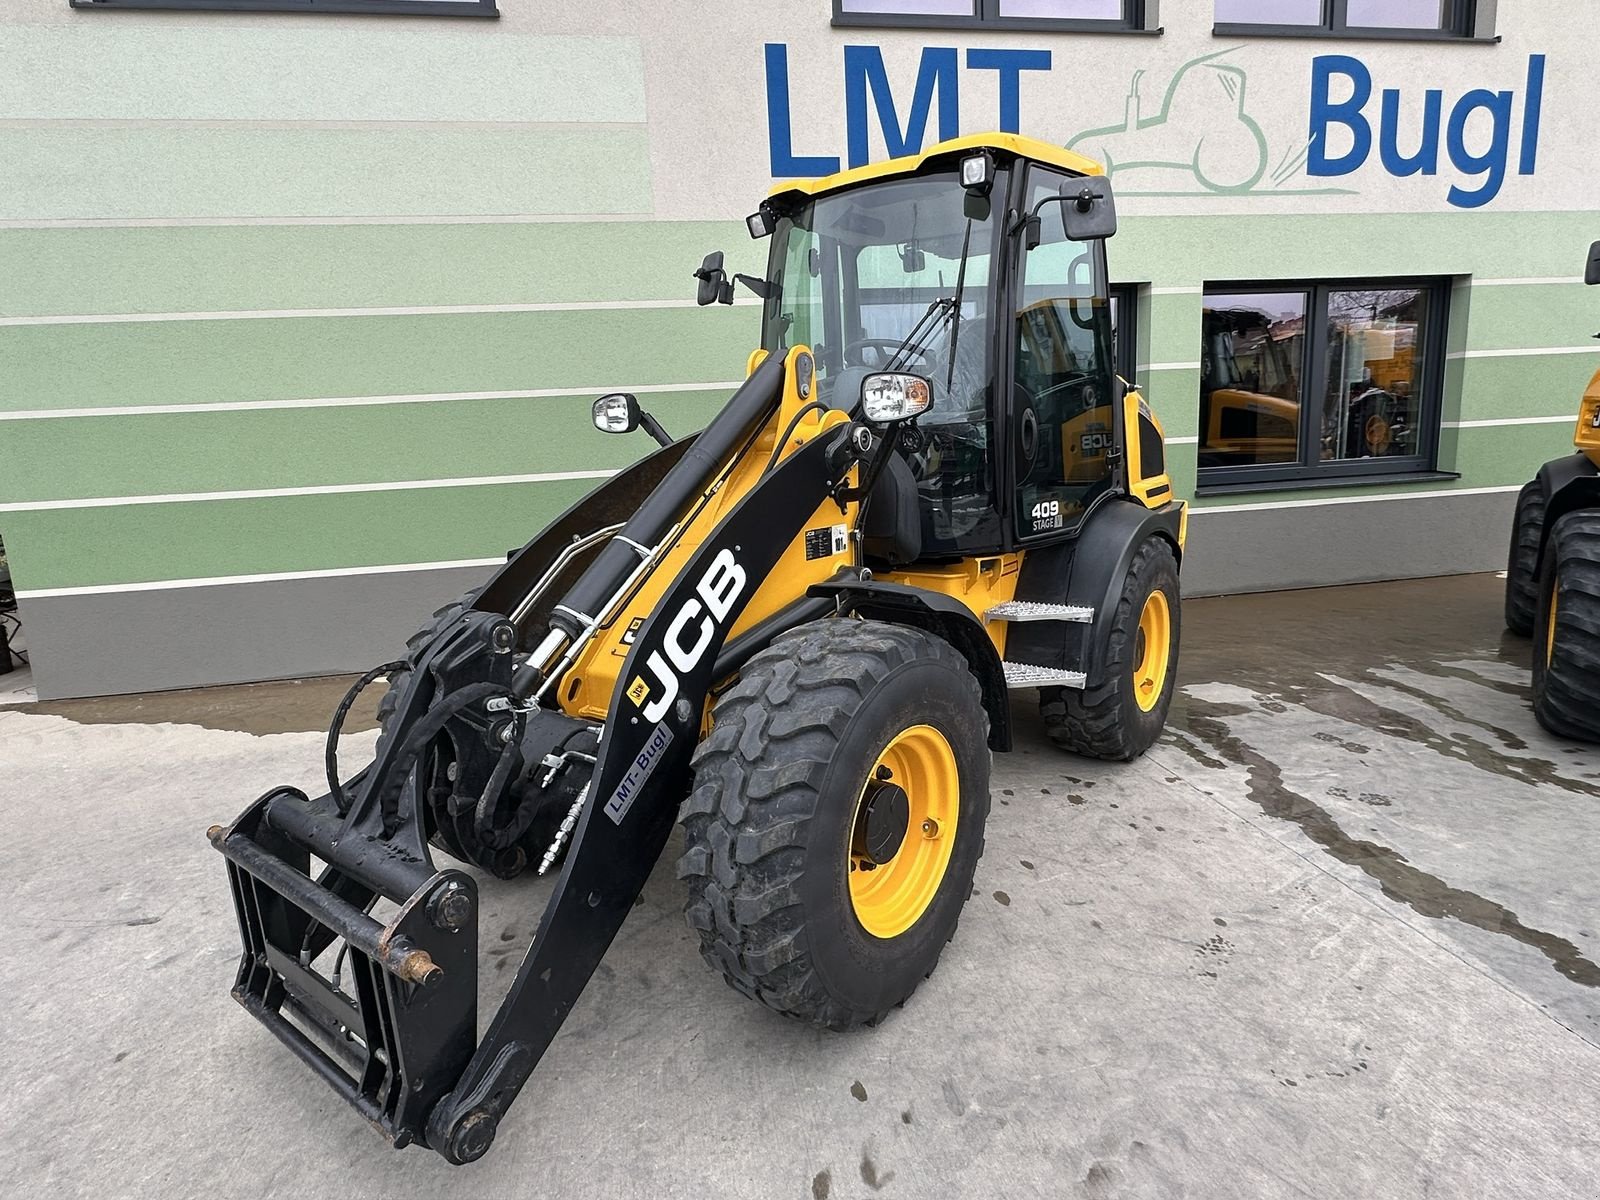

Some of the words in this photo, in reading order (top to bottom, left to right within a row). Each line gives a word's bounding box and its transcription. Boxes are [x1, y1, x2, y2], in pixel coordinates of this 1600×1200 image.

[764, 43, 1052, 178] LMT
[1306, 54, 1546, 209] Bugl
[1031, 500, 1059, 519] 409
[1032, 517, 1054, 531] STAGE
[642, 548, 747, 724] JCB
[636, 727, 667, 771] Bugl
